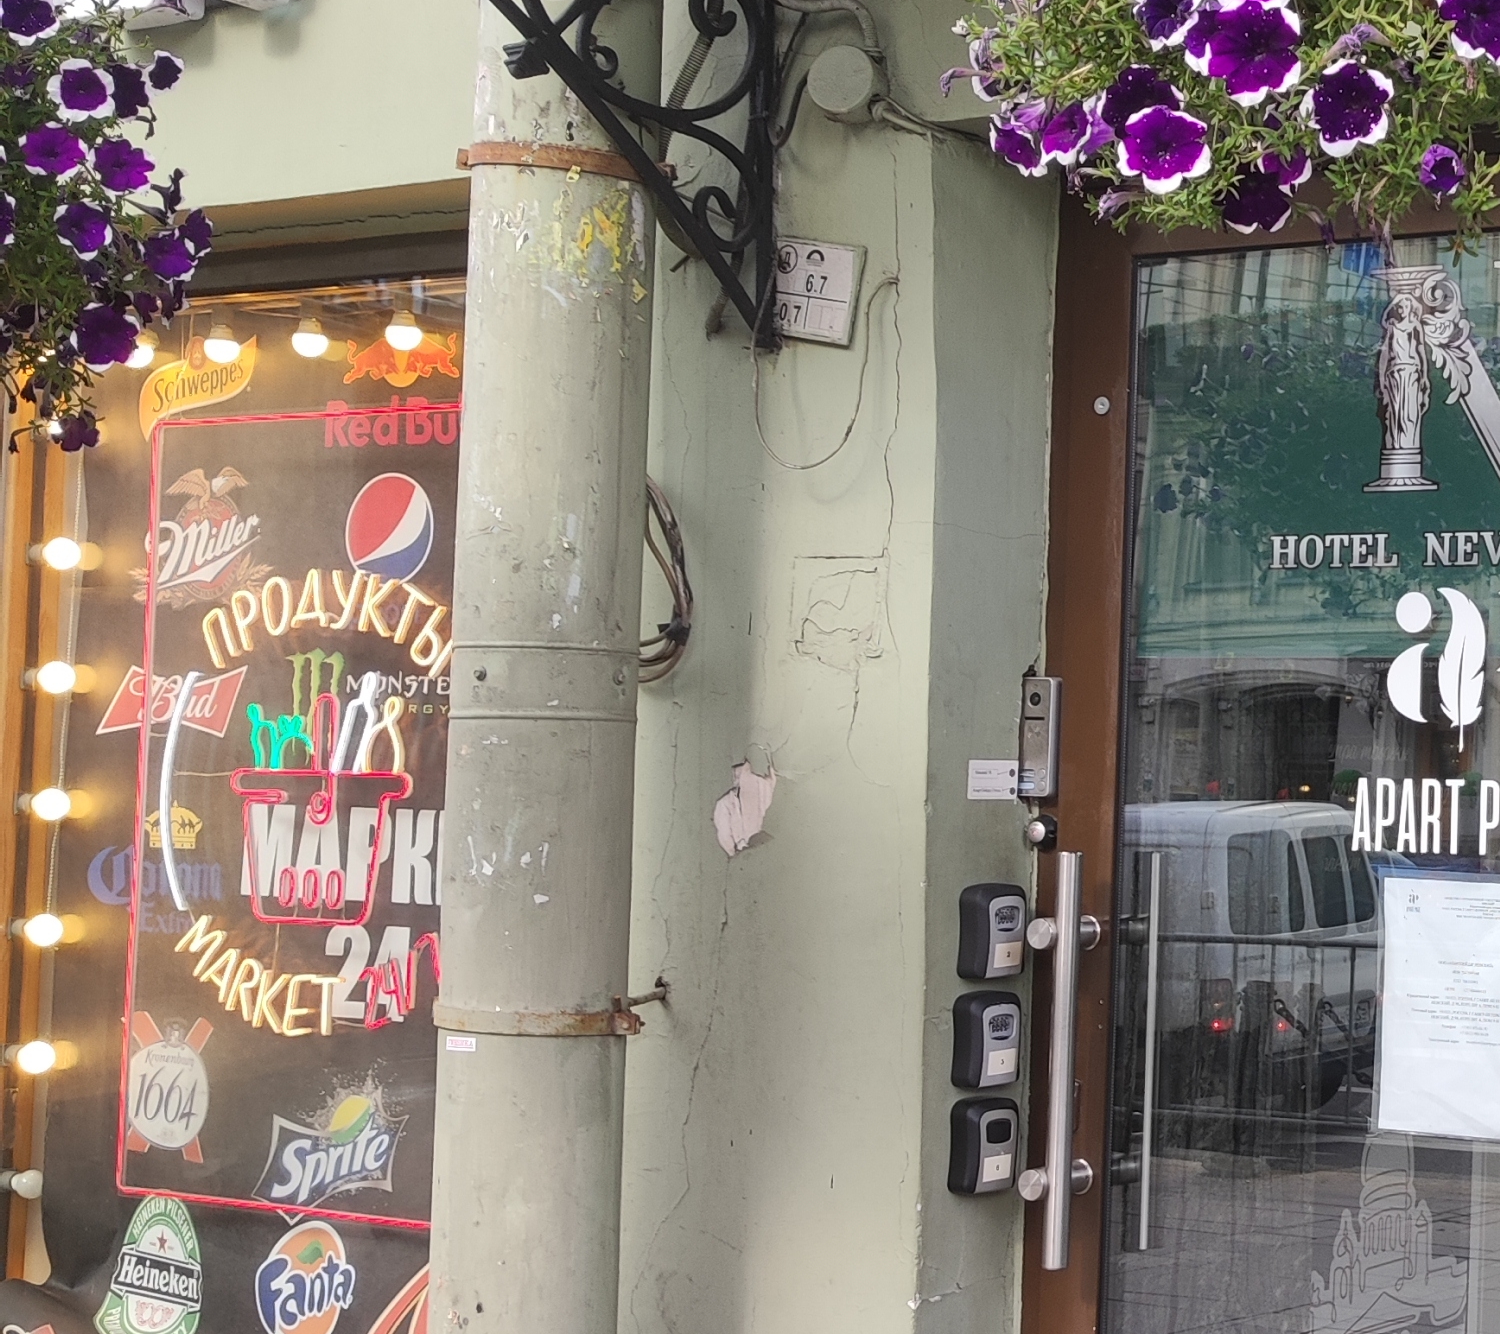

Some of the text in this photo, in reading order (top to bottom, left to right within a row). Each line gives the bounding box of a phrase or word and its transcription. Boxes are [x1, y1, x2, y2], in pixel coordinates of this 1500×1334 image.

[151, 359, 244, 413] Schweppes
[325, 392, 462, 448] Red Bu
[145, 514, 261, 584] Miller
[1269, 533, 1398, 570] HOTEL
[202, 568, 453, 678] ПРОДУКТЫ
[240, 803, 443, 906] МАРК
[1352, 777, 1464, 857] APART
[175, 915, 346, 1036] MARKET
[134, 1066, 198, 1131] 1664
[270, 1116, 391, 1205] Sprite
[117, 1255, 199, 1300] Heineken
[257, 1251, 354, 1334] Fanta
